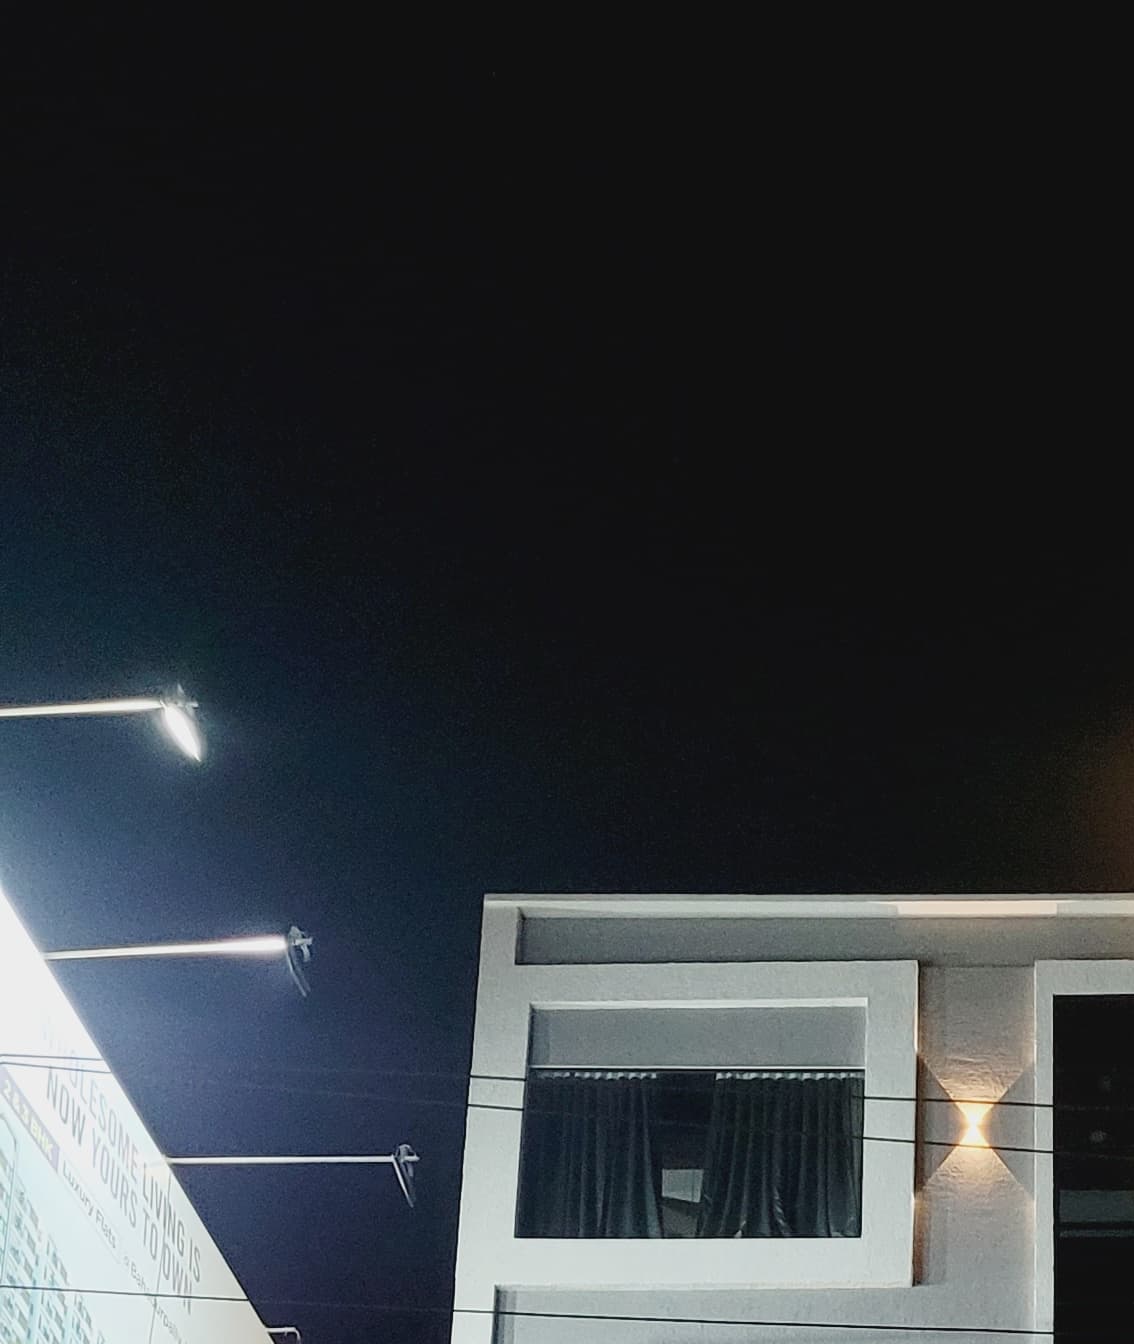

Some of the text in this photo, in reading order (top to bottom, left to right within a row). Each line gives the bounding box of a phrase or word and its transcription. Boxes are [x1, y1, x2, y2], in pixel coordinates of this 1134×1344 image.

[46, 1067, 193, 1316] NOW YOURS TO OWN
[62, 1160, 93, 1217] Luxury
[95, 1214, 117, 1250] Flats
[142, 1163, 186, 1256] LIVING
[188, 1238, 202, 1284] IS
